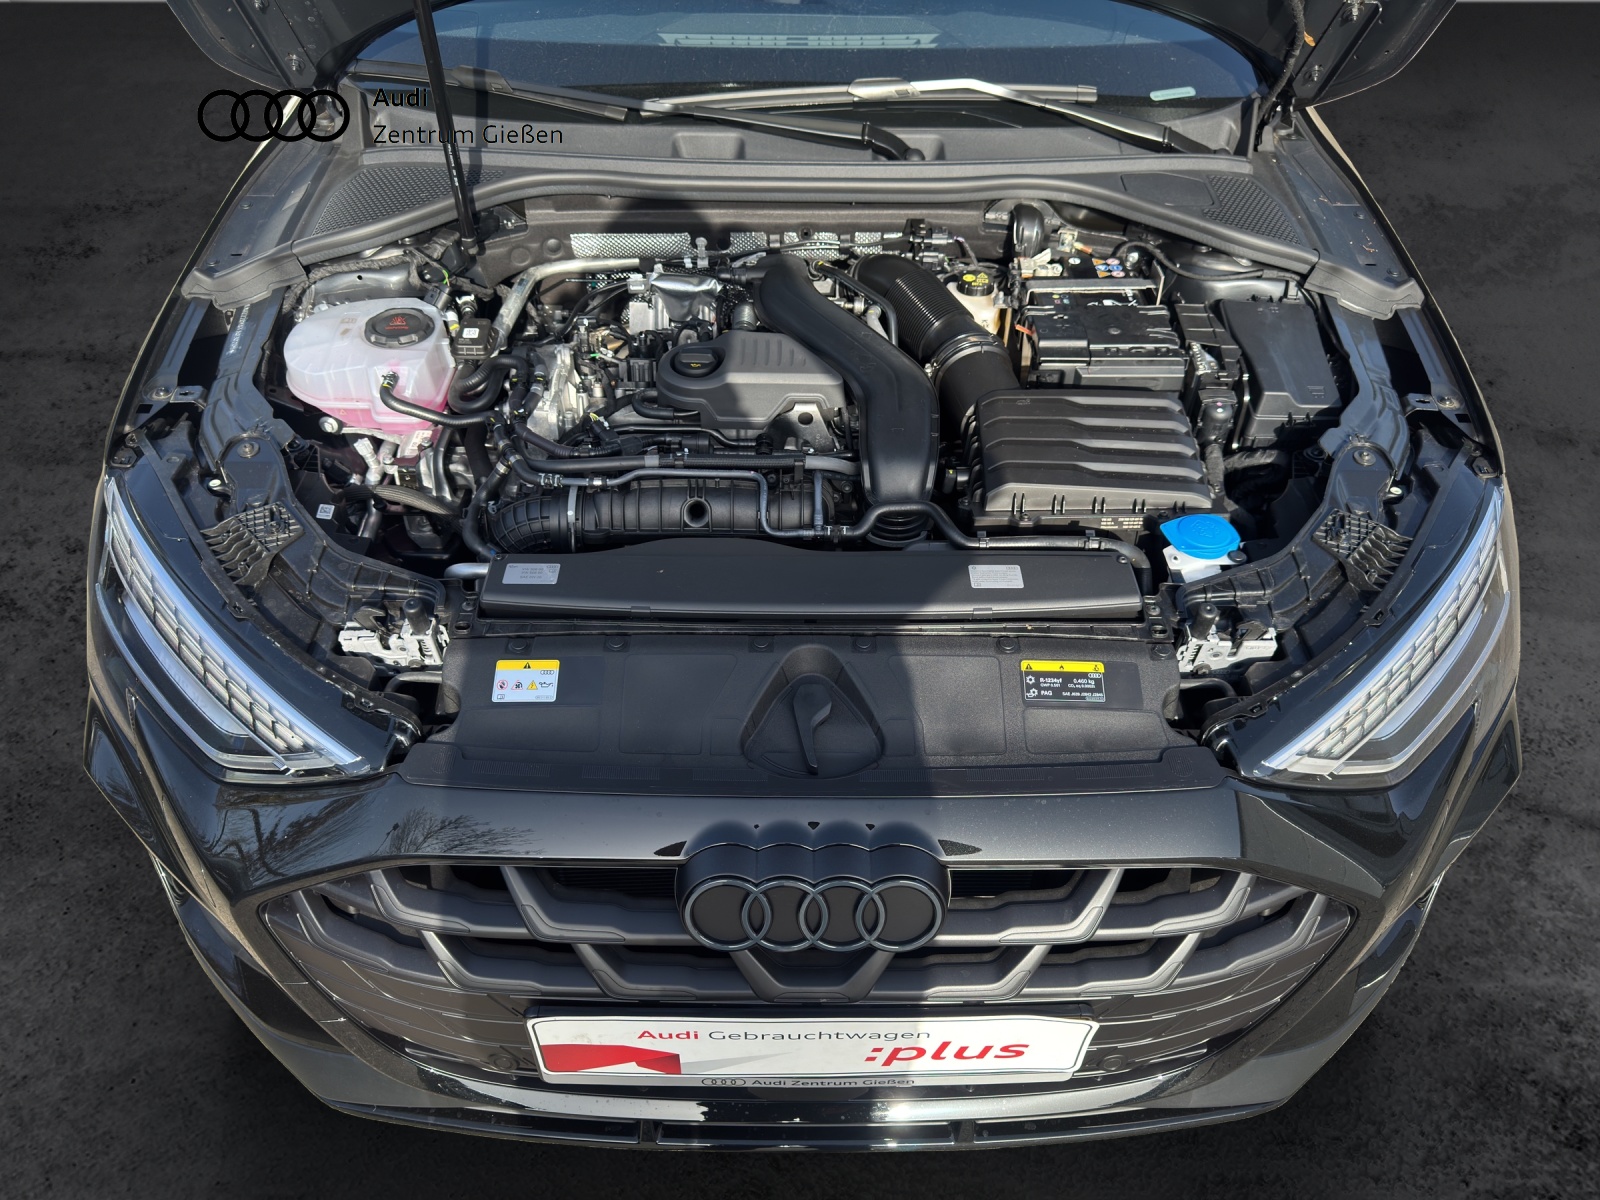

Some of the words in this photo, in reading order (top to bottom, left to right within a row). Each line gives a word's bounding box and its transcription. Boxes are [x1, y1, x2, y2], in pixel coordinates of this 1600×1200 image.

[637, 1030, 699, 1040] Audi
[709, 1031, 930, 1042] Gebrauchtwagen
[863, 1078, 914, 1087] Gießen
